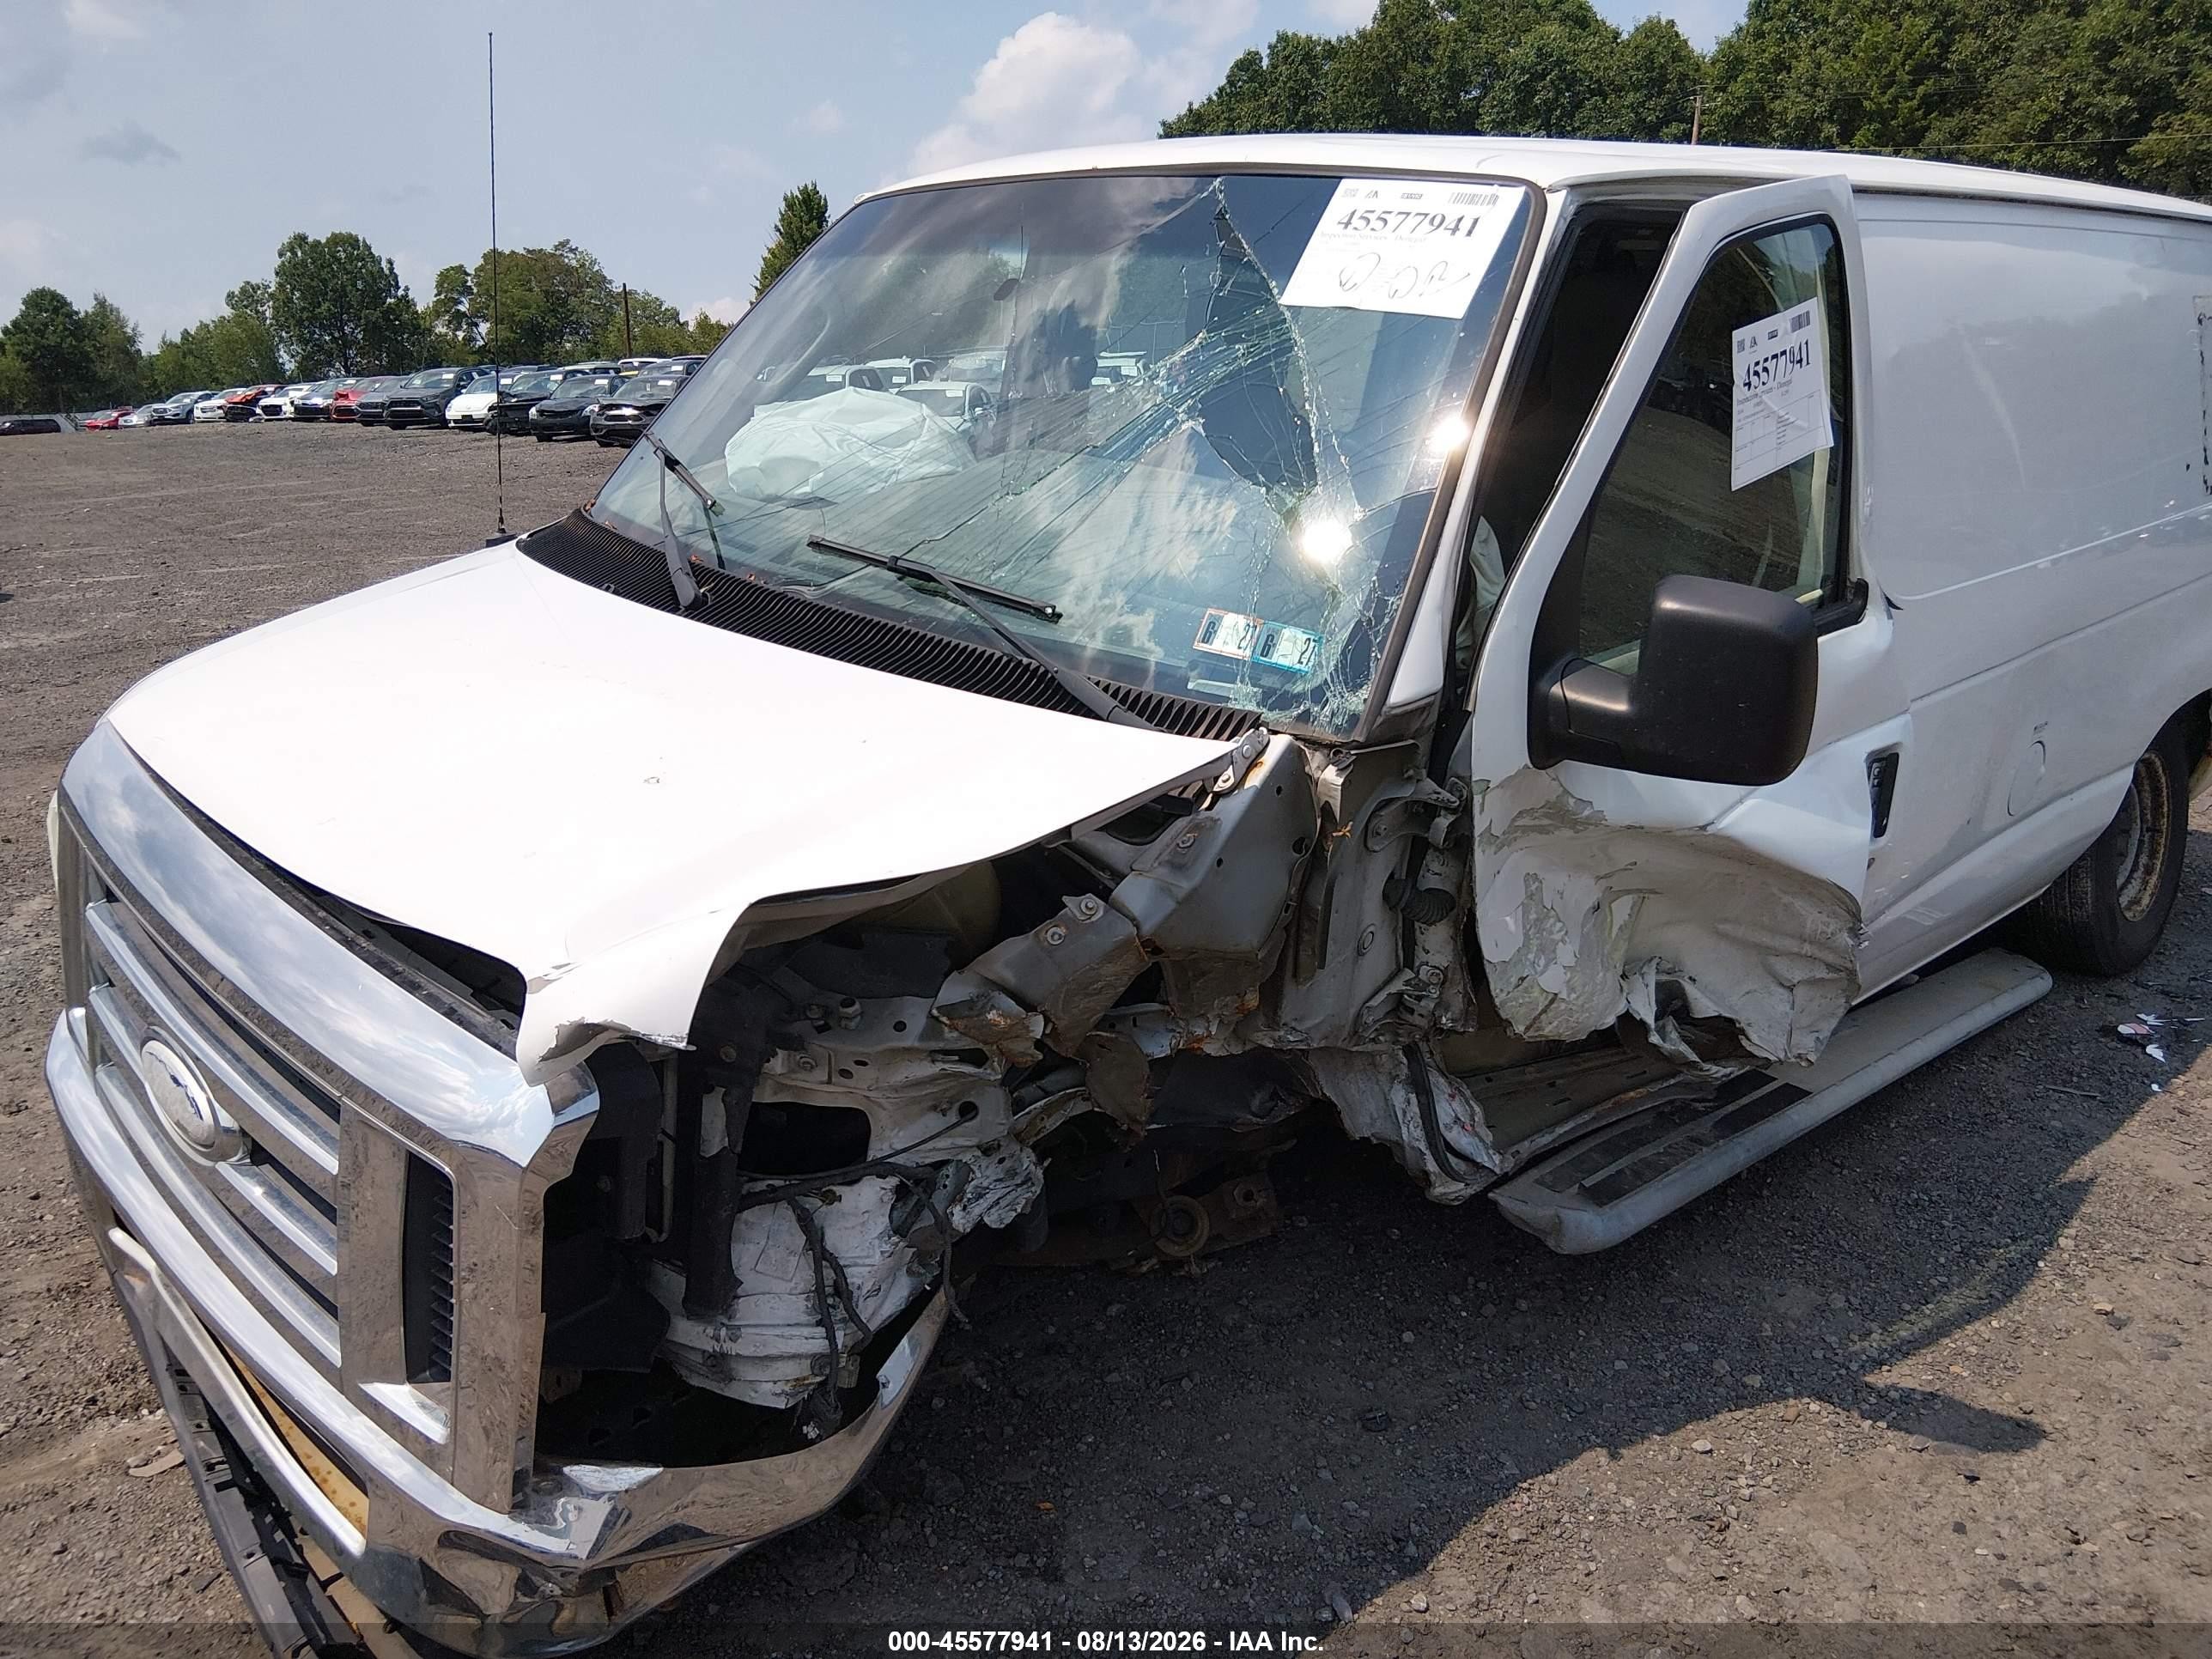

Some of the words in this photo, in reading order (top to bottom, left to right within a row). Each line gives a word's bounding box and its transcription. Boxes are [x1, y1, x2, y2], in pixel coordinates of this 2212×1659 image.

[1337, 209, 1480, 238] 45577941
[1743, 338, 1811, 392] 45577941
[1201, 621, 1217, 644] 6
[1260, 634, 1277, 658] 6
